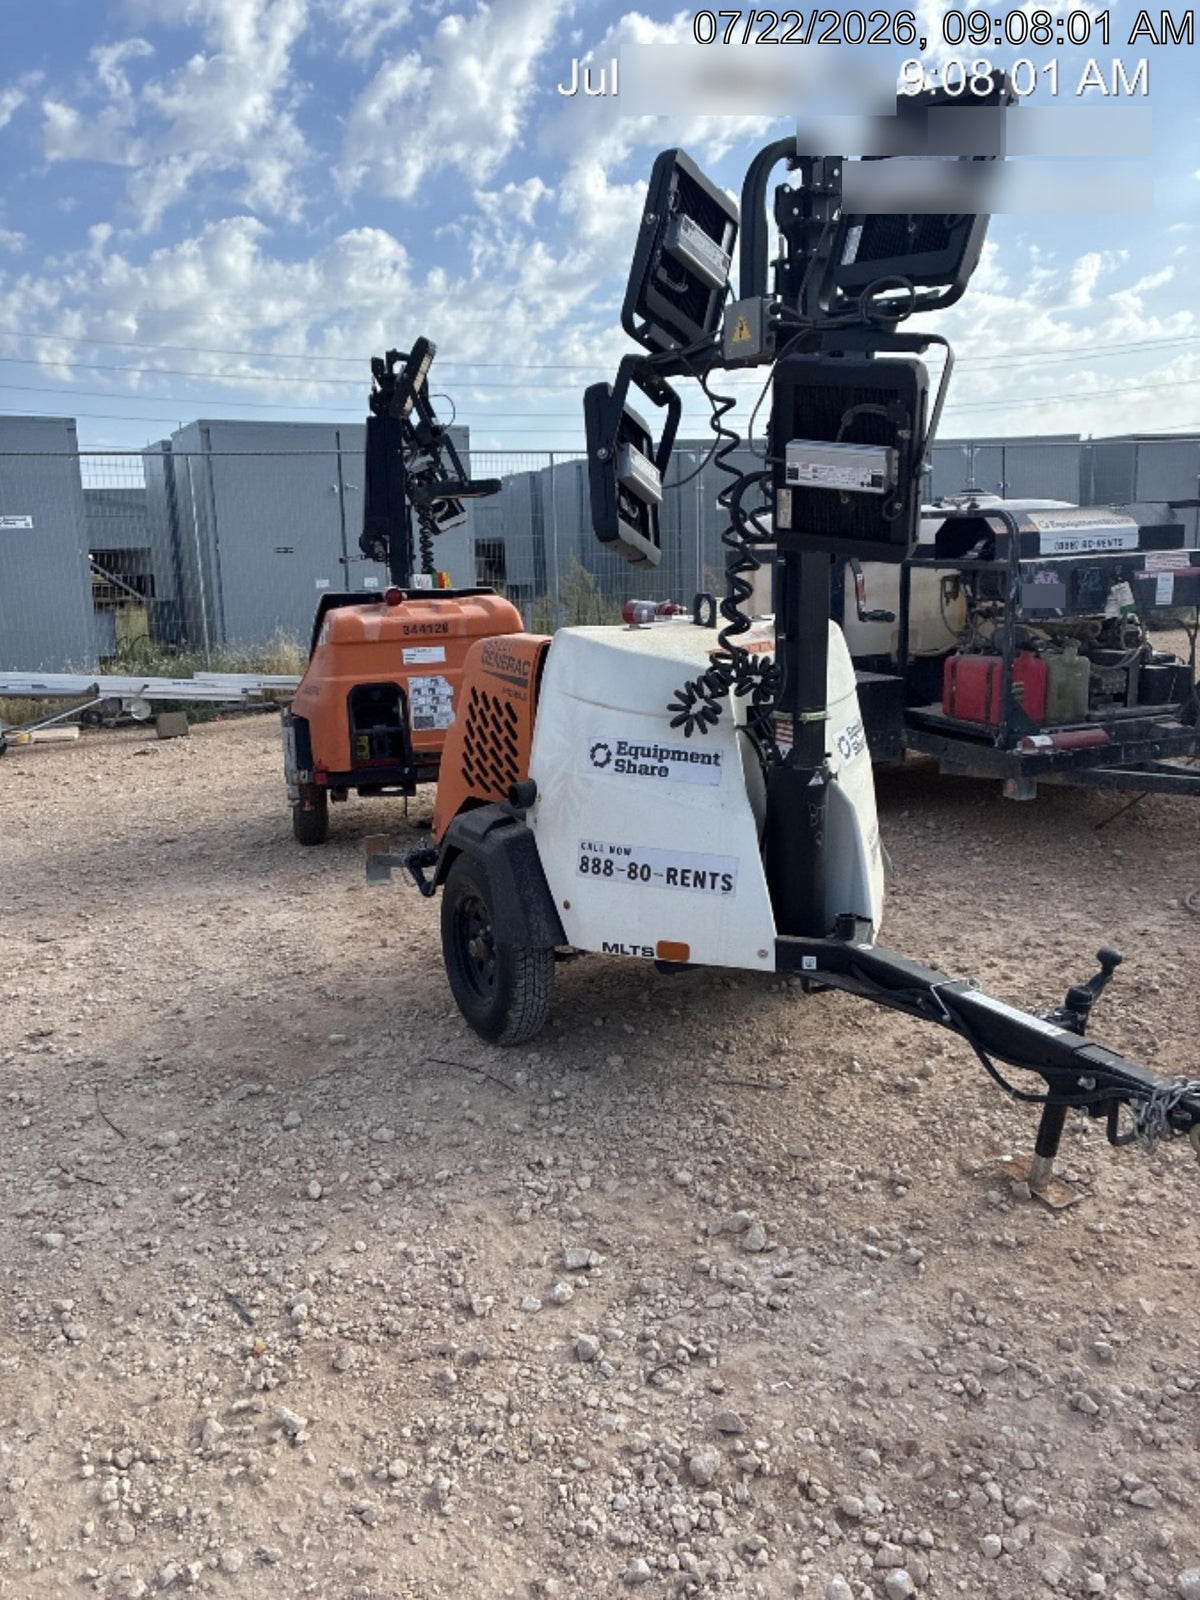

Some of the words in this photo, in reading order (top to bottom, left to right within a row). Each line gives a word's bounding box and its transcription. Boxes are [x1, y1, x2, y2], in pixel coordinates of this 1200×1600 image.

[616, 741, 720, 766] Equipment
[614, 758, 669, 777] Share
[580, 842, 604, 853] CALL
[609, 846, 632, 856] NOW
[579, 855, 733, 892] 888-80-RENTS
[602, 941, 655, 957] MLTS
